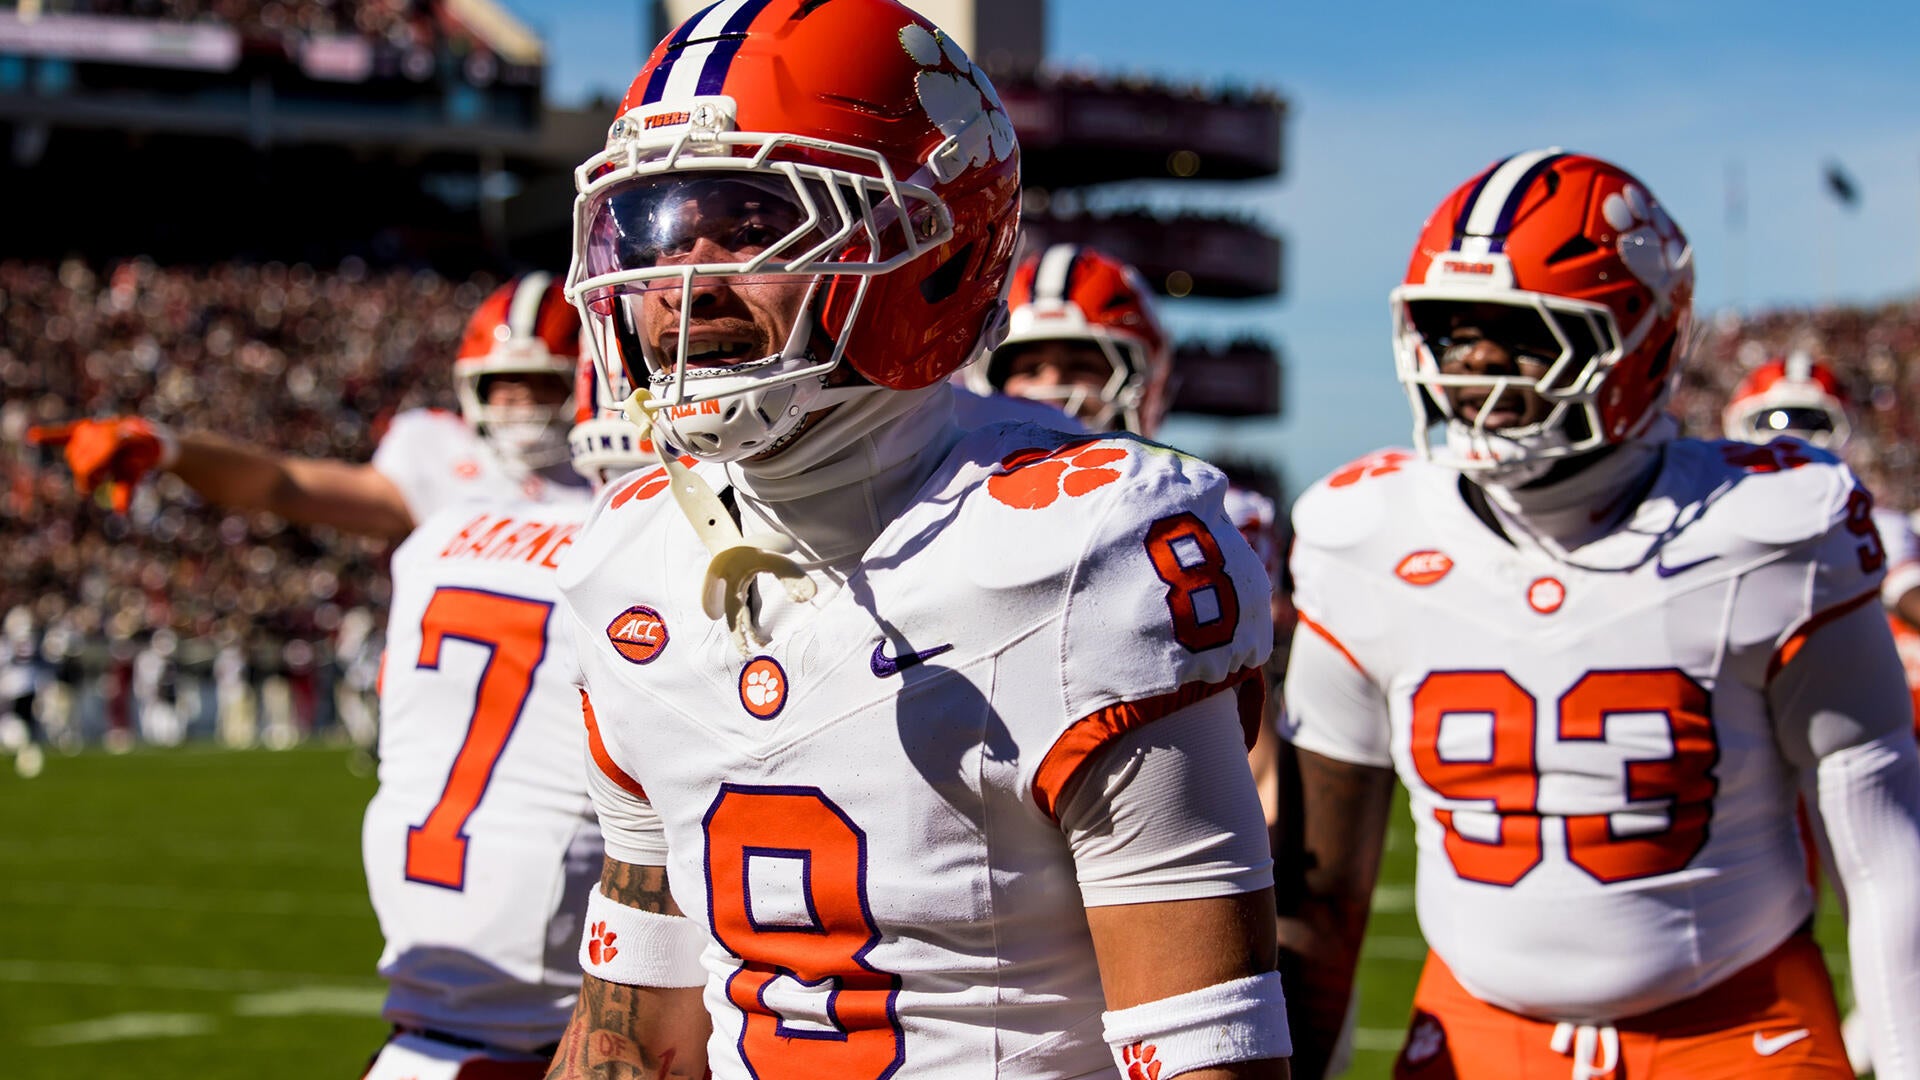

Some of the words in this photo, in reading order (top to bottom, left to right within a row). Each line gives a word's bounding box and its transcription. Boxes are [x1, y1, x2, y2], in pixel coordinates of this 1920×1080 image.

[644, 111, 690, 130] TIGERS
[671, 404, 697, 421] ALL
[701, 399, 721, 415] IN
[616, 619, 662, 641] ACC
[1143, 510, 1239, 654] 8
[405, 586, 555, 893] 7
[1410, 667, 1719, 888] 93
[700, 782, 906, 1080] 8
